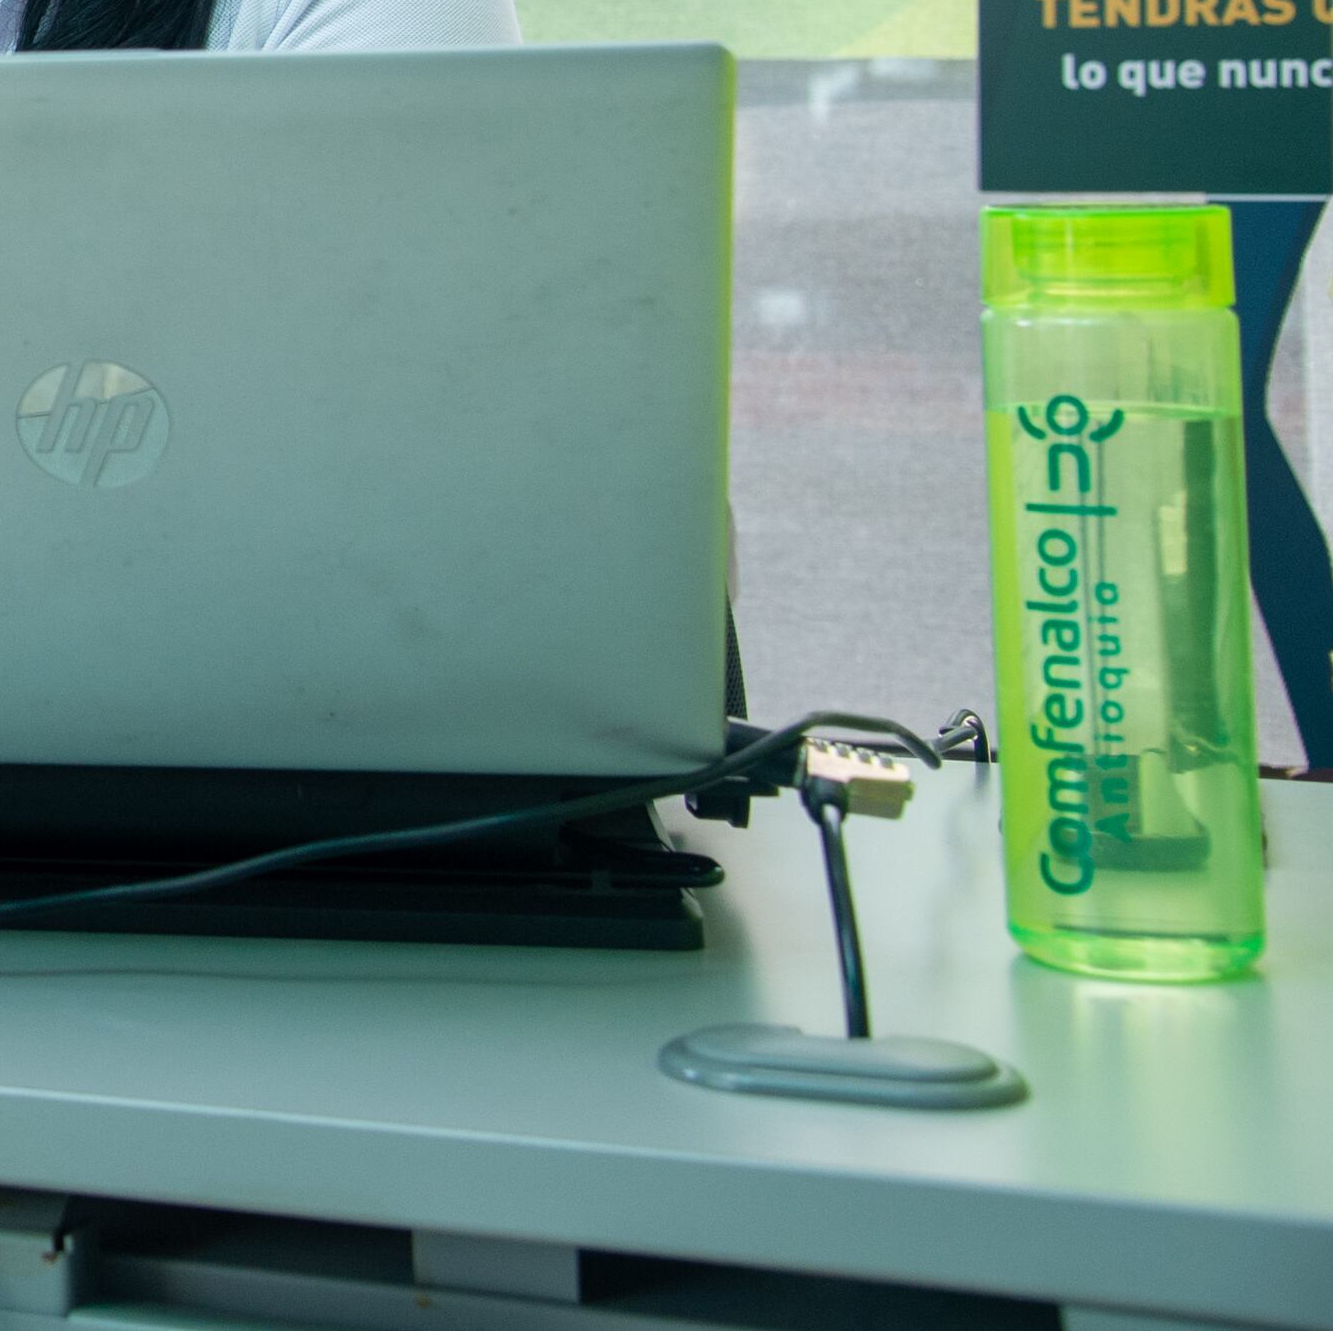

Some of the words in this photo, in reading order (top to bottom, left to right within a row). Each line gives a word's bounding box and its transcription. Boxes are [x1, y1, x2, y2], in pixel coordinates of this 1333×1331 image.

[1062, 53, 1107, 90] lo
[1118, 59, 1206, 97] que
[1025, 528, 1095, 896] Comfenalco
[1092, 581, 1133, 844] Antioquia
